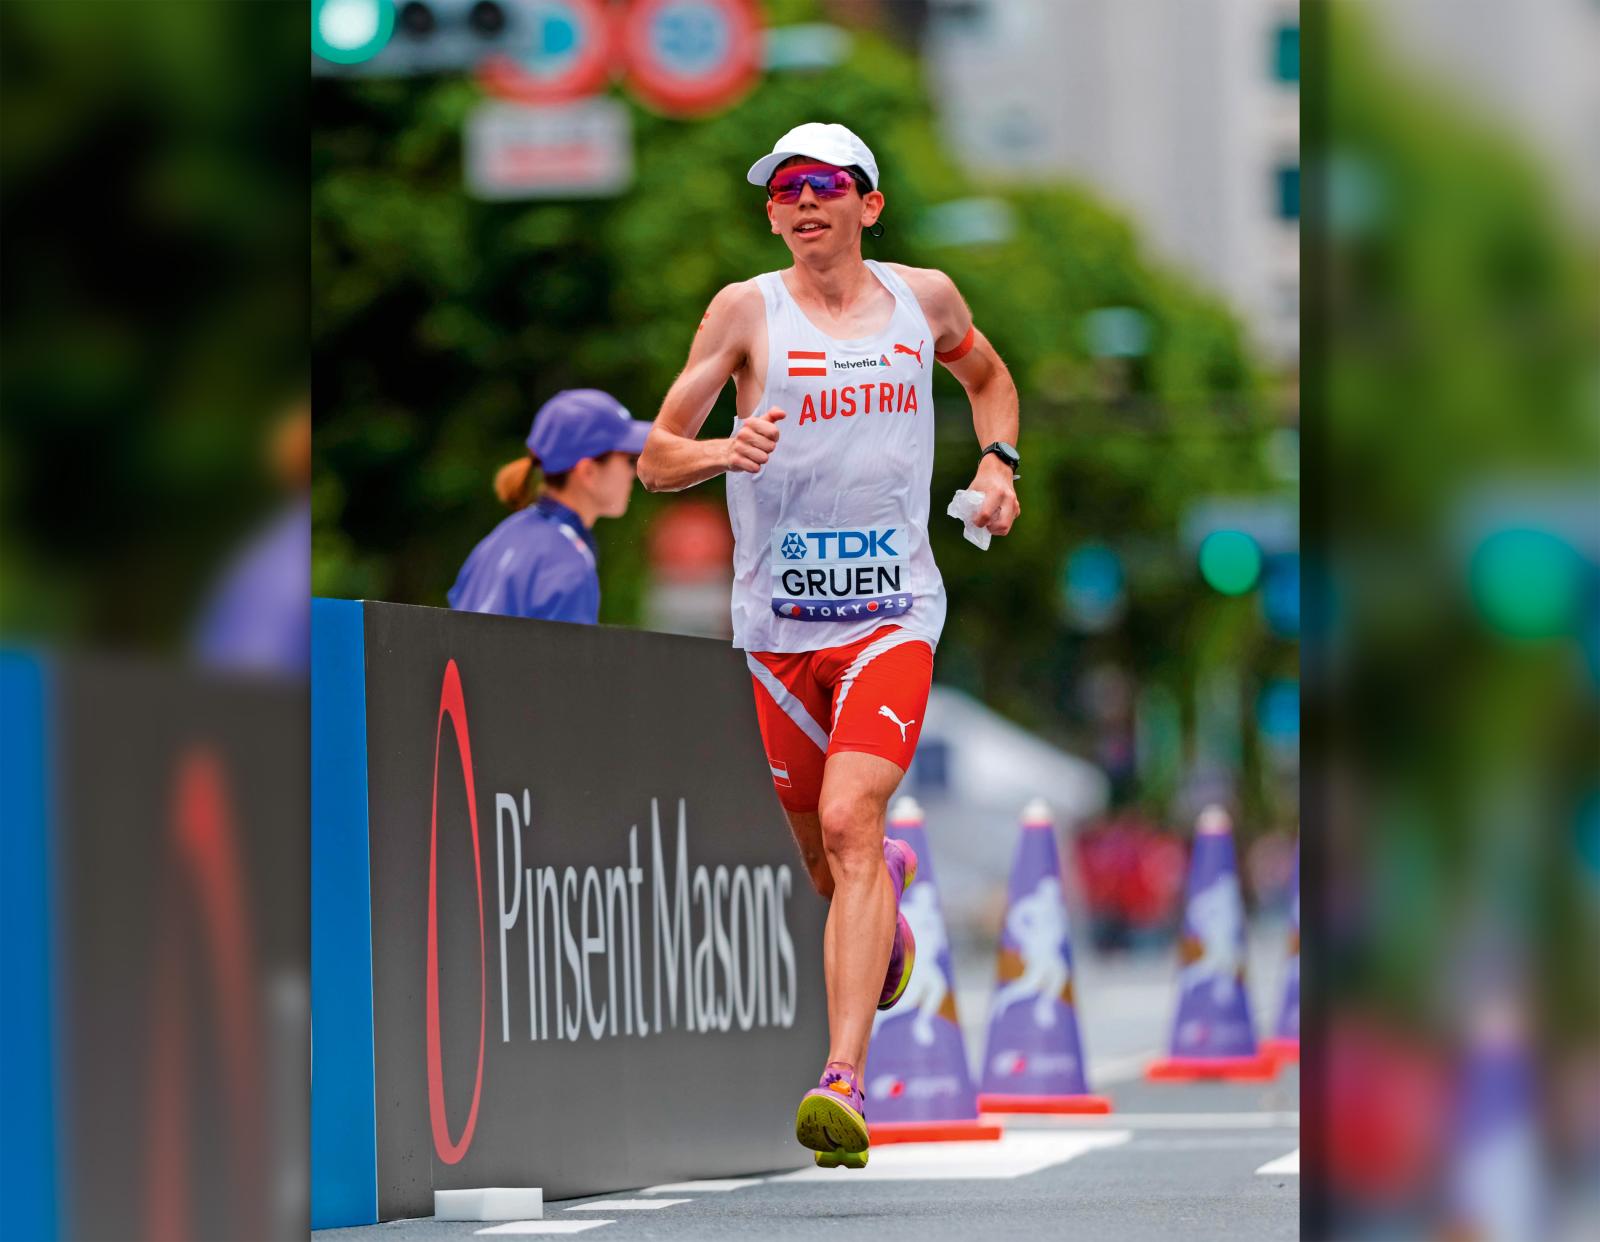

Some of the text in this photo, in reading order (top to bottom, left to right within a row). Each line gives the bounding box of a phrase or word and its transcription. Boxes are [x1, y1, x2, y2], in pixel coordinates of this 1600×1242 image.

[833, 358, 877, 369] helvetia
[799, 382, 917, 425] AUSTRIA
[806, 528, 899, 560] TDK
[781, 565, 901, 597] GRUEN
[651, 797, 797, 1034] Masons
